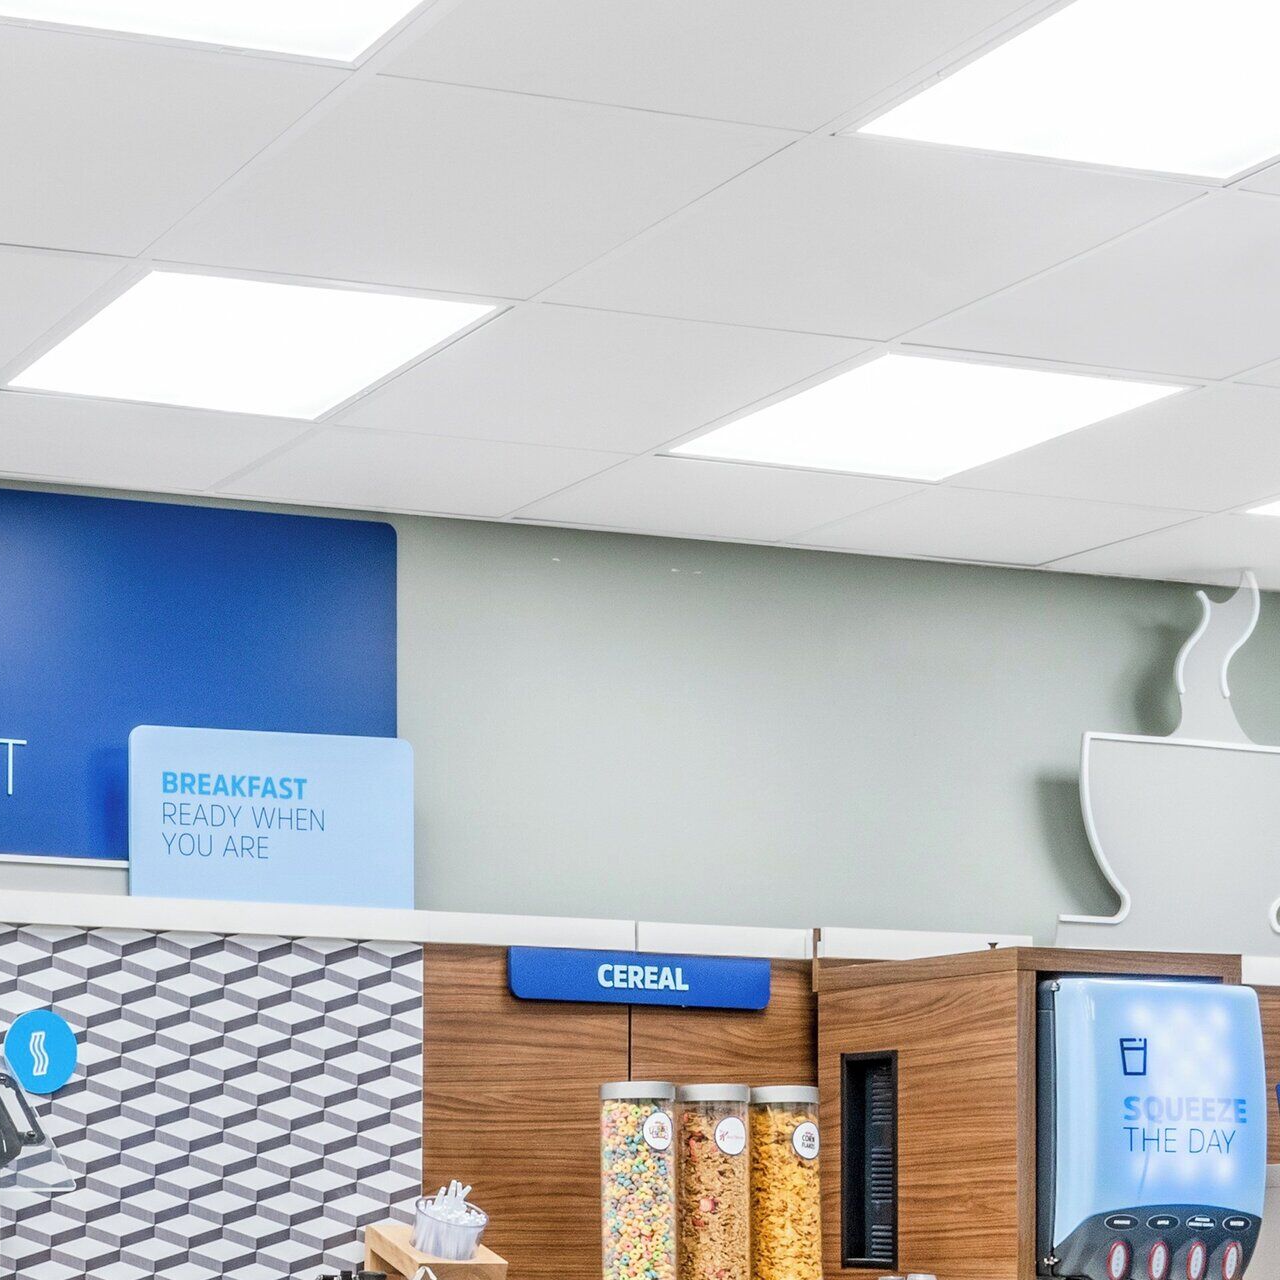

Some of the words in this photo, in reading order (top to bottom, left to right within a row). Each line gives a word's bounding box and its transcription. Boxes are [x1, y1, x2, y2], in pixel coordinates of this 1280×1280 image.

[162, 771, 307, 800] BREAKFAST
[162, 802, 242, 828] READY
[252, 806, 325, 832] WHEN
[162, 832, 213, 857] YOU
[223, 835, 269, 859] ARE
[597, 963, 689, 991] CEREAL
[1123, 1096, 1247, 1124] SQUEEZE
[1123, 1127, 1177, 1153] THE
[1190, 1128, 1236, 1154] DAY
